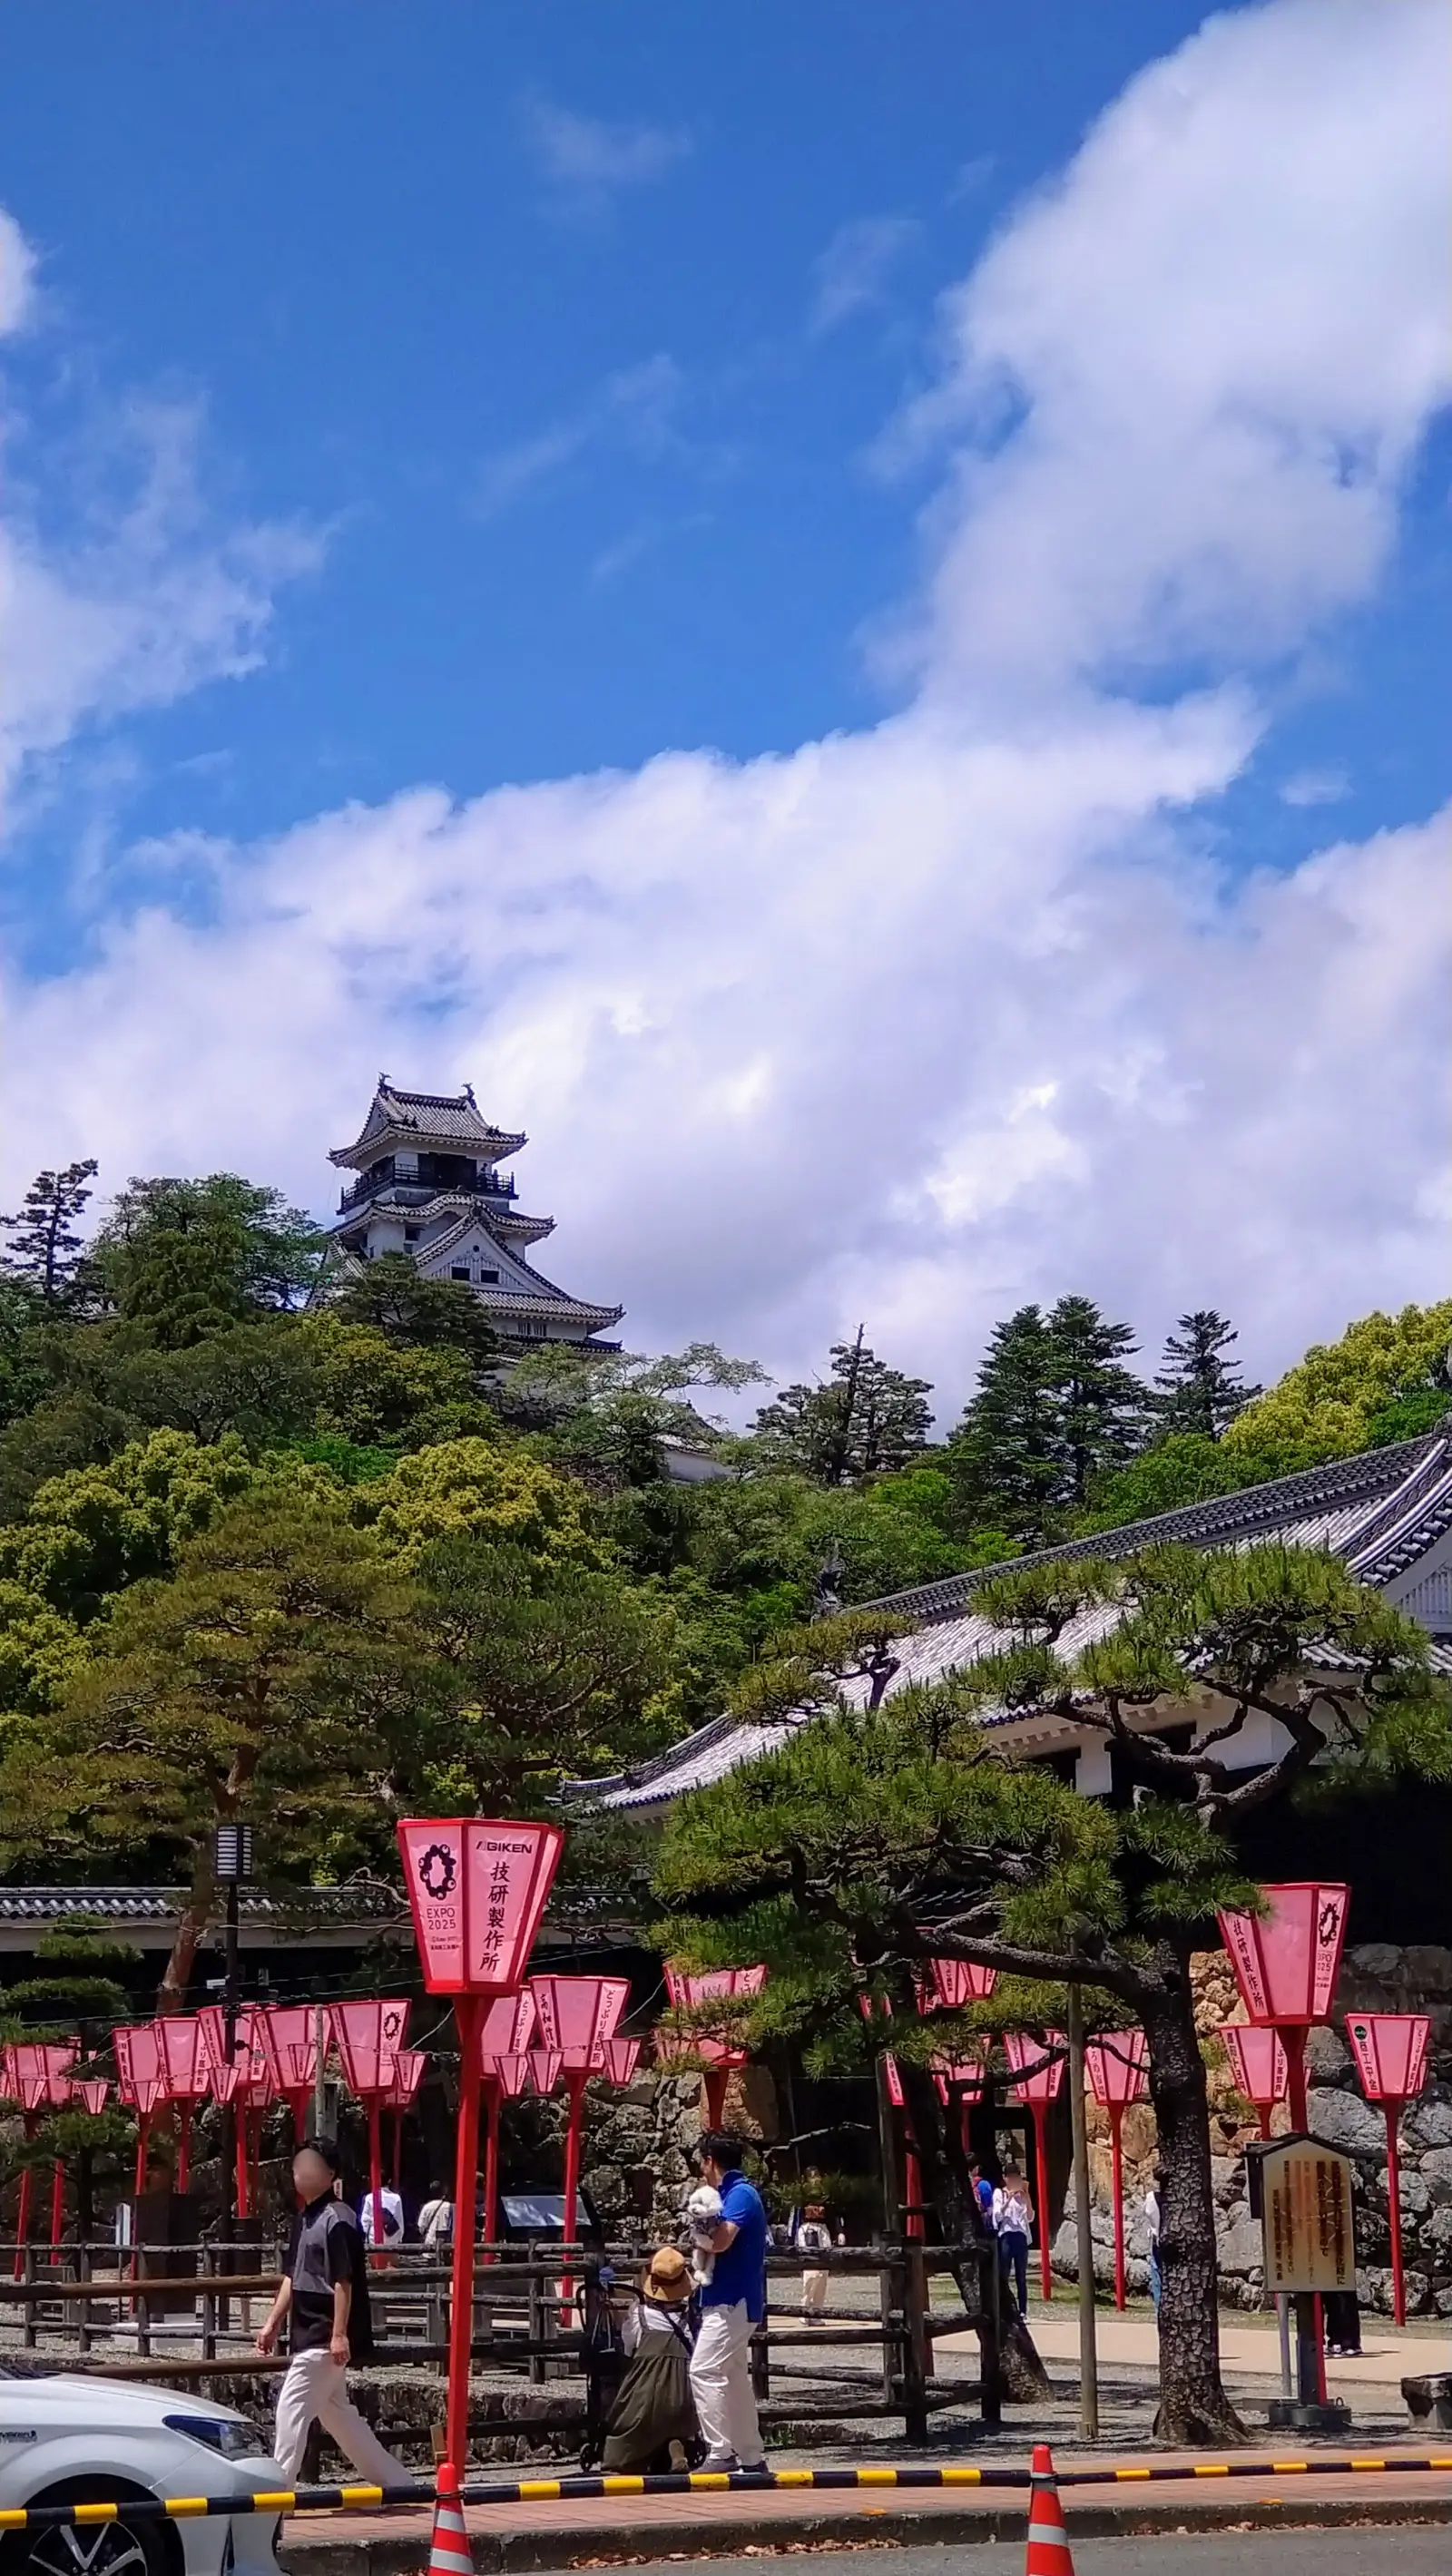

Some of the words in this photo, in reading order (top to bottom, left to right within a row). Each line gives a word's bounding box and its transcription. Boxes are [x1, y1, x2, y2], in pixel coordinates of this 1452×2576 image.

[427, 1907, 456, 1918] EXPO
[428, 1918, 456, 1930] 2025
[478, 1861, 511, 1973] 技研製作所
[1233, 1919, 1264, 2009] 技研製作所
